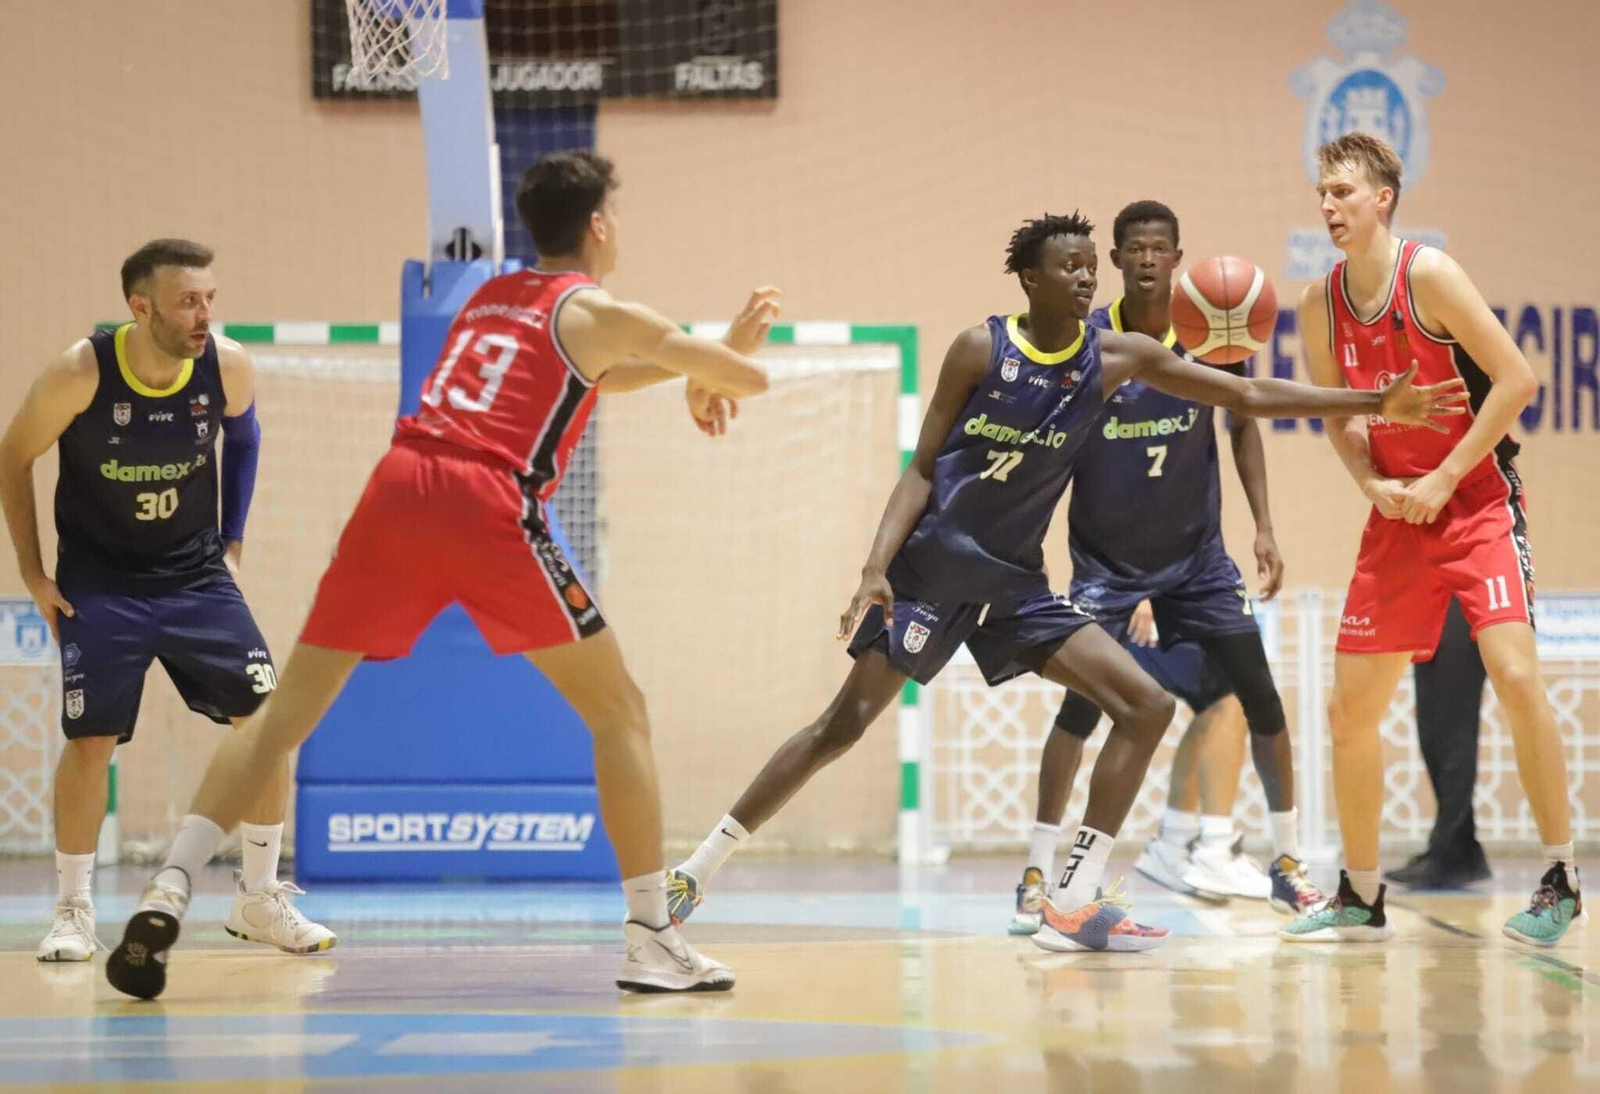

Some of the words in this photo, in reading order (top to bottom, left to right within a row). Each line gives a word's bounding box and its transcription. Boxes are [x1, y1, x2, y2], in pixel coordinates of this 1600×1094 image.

[675, 62, 764, 91] FALTAS
[421, 329, 519, 412] 13
[1146, 445, 1168, 477] 7
[135, 487, 179, 521] 30
[1485, 575, 1512, 612] 11
[245, 663, 278, 694] 30
